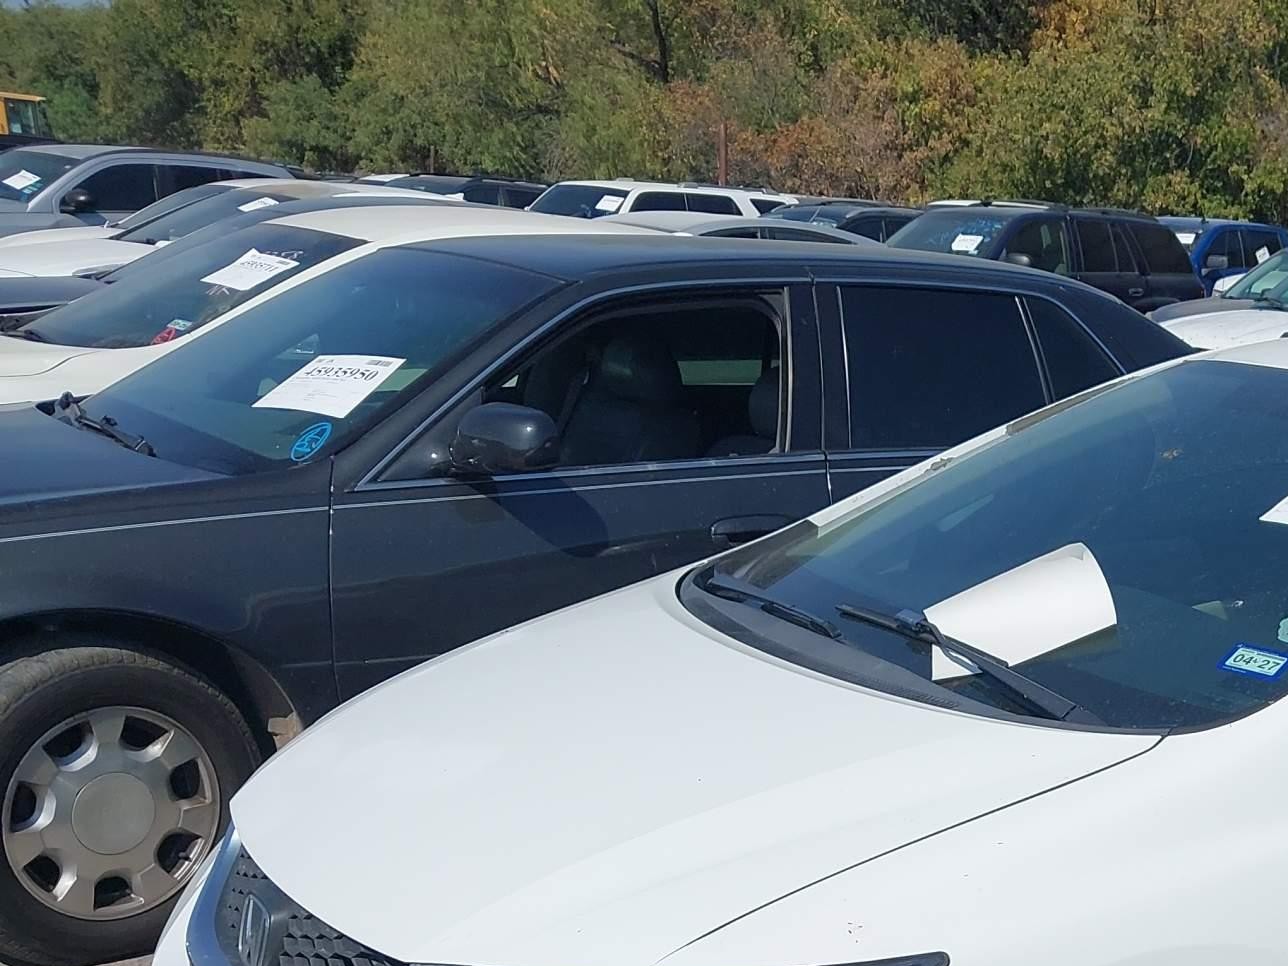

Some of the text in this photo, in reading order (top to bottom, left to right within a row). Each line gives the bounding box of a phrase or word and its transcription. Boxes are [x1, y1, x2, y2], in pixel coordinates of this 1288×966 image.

[305, 366, 379, 381] 45935950
[1232, 653, 1280, 671] 04 27
